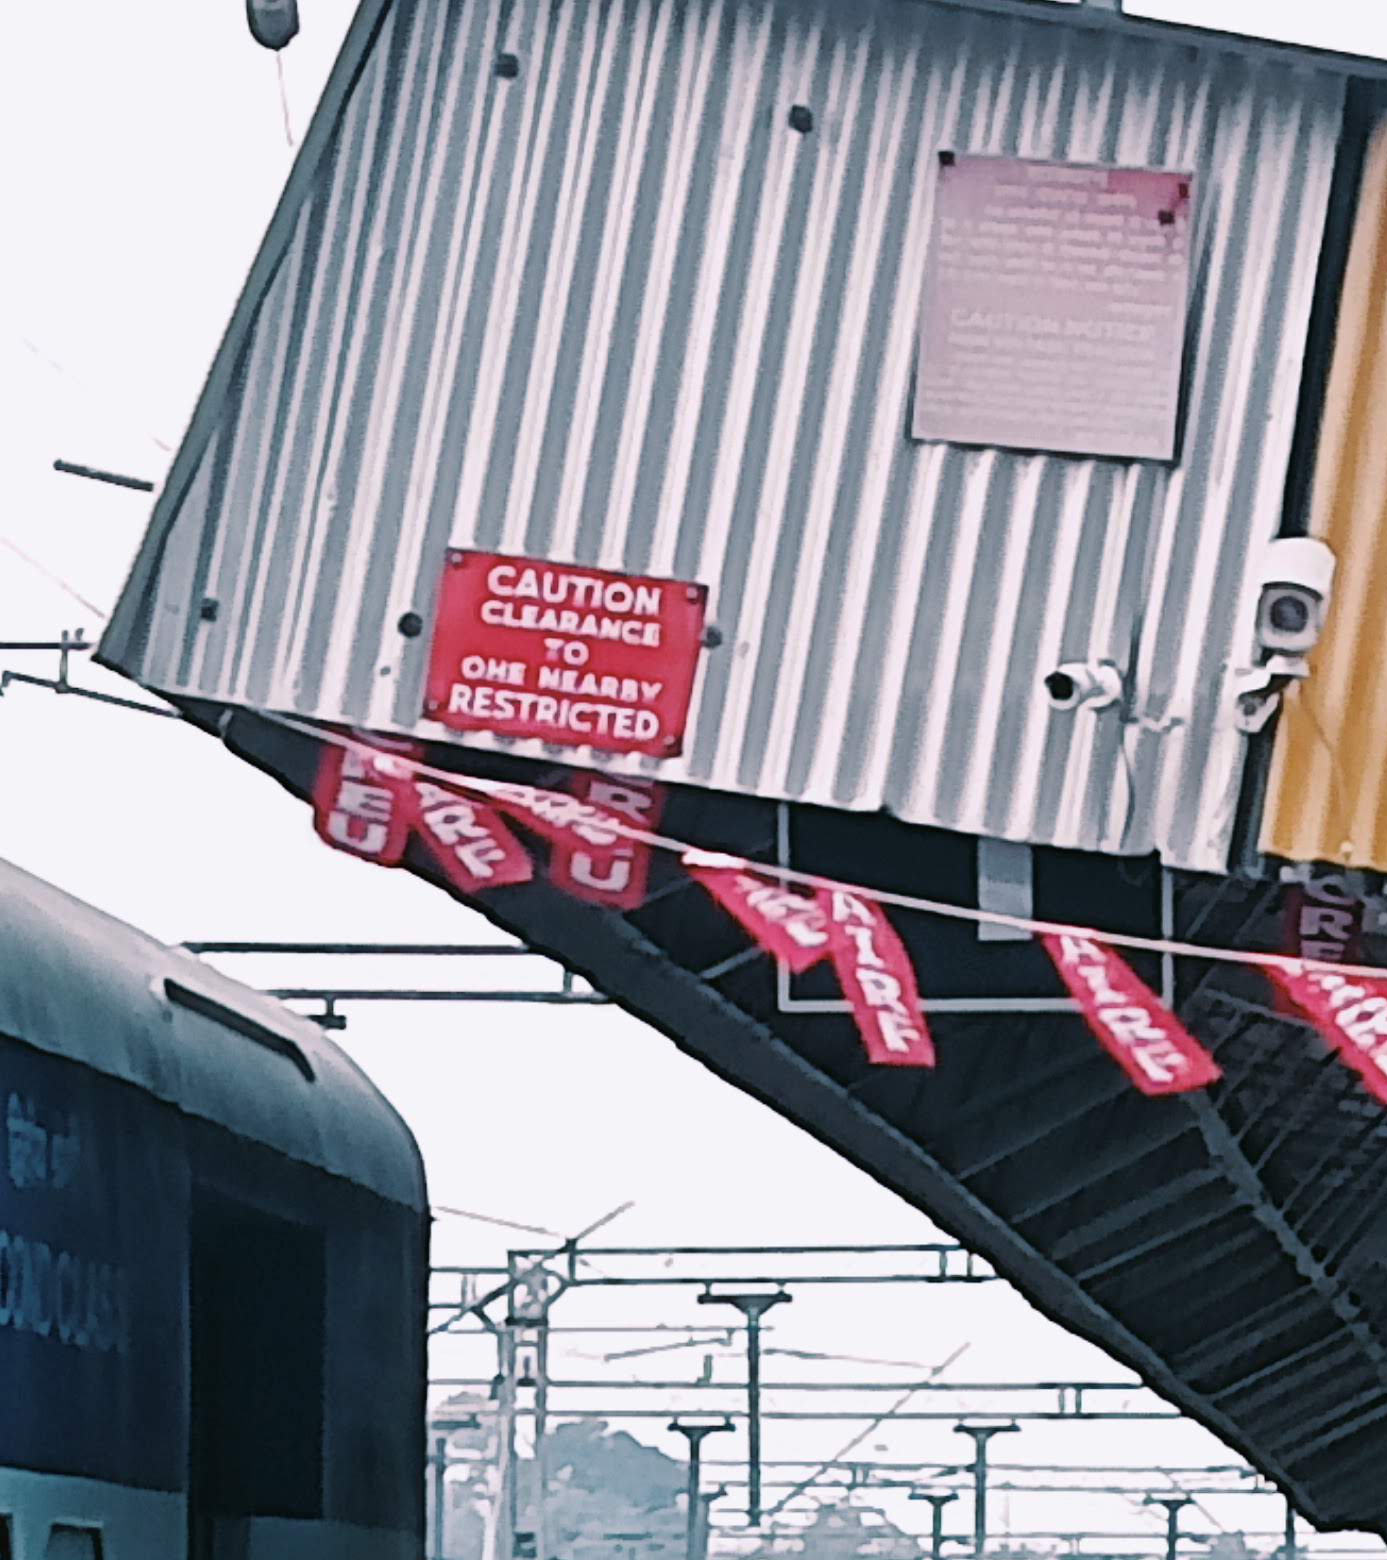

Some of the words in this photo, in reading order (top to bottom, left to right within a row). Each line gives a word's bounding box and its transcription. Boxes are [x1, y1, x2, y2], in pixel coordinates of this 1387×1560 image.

[487, 565, 662, 616] CAUTION
[481, 599, 662, 648] CLEARANCE
[544, 637, 590, 666] TO
[538, 665, 662, 704] NEARBY
[448, 682, 660, 741] RESTRICTED
